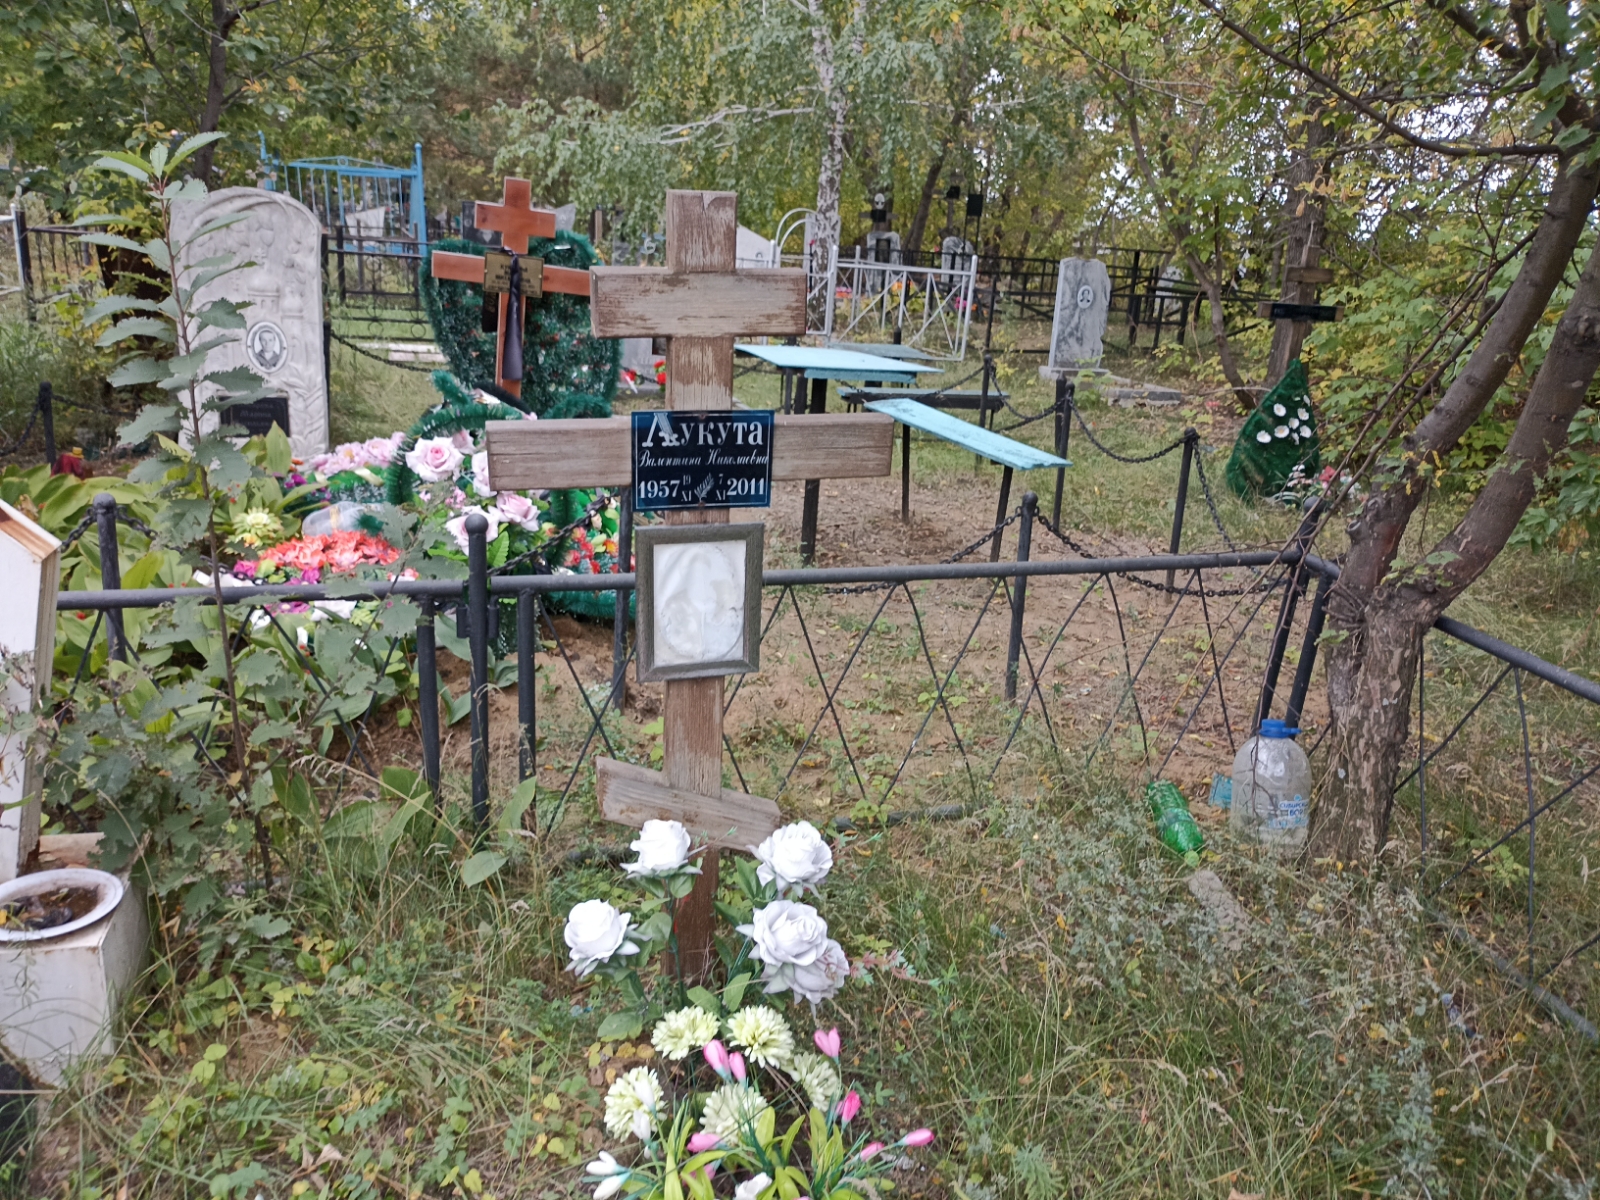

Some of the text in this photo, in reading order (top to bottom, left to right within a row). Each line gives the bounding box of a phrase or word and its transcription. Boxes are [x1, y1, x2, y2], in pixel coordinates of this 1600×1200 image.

[641, 412, 764, 448] Лукута
[639, 448, 770, 468] Валентина Николаевна
[638, 477, 765, 499] 1957 2011
[683, 474, 691, 486] 19
